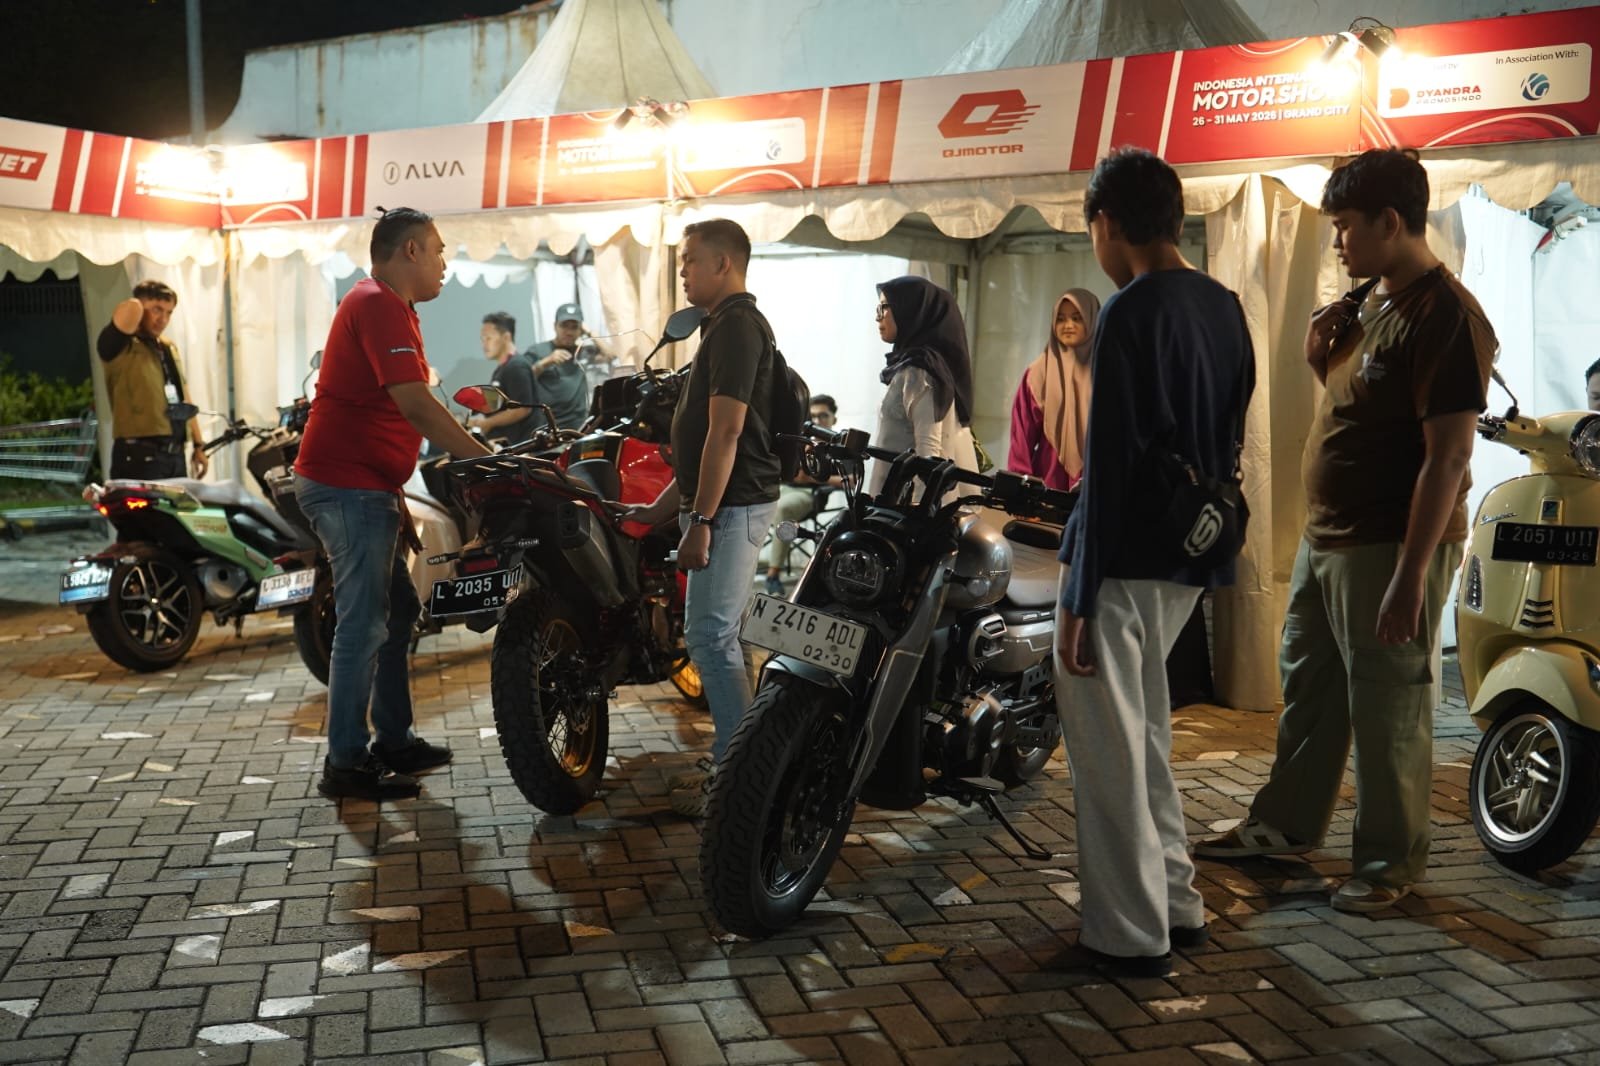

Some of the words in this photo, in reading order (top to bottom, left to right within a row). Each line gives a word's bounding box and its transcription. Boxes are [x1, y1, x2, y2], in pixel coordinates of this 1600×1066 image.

[1496, 56, 1504, 65] In
[1505, 52, 1554, 64] Association
[1555, 50, 1580, 60] With:
[1193, 76, 1254, 92] INDONESIA
[1416, 84, 1482, 98] DYANDRA
[1192, 86, 1275, 112] MOTOR
[1278, 80, 1343, 105] SHO
[1192, 116, 1205, 126] 26
[1214, 115, 1224, 125] 31
[1226, 113, 1250, 124] MAY
[1284, 108, 1323, 119] GRAND
[1324, 104, 1350, 116] CITY
[942, 144, 1024, 158] QJMOTOR
[405, 160, 465, 180] ALVA
[1497, 525, 1505, 541] L
[1512, 526, 1554, 544] 2051
[436, 584, 445, 599] L
[455, 577, 492, 598] 2035
[752, 598, 768, 618] N
[772, 604, 818, 635] 2416
[825, 622, 858, 649] ADL
